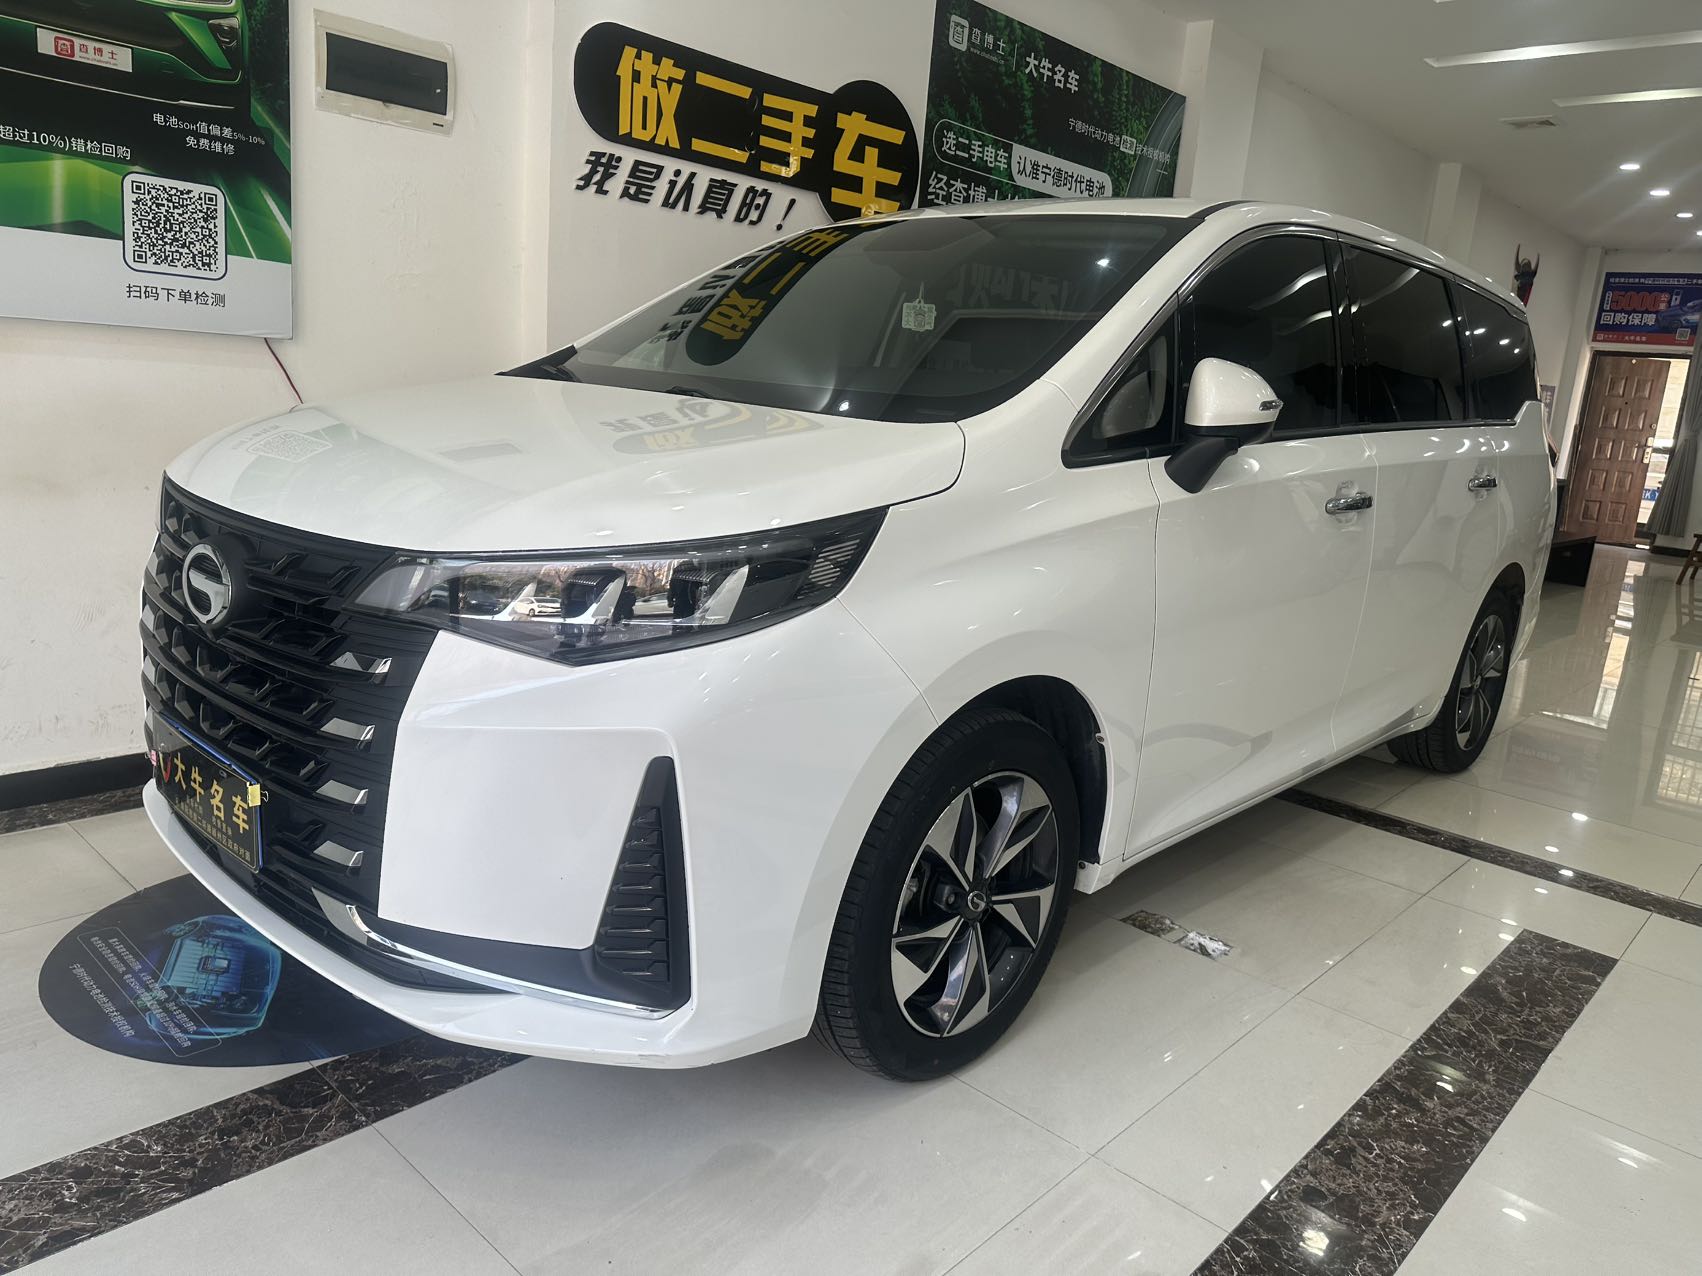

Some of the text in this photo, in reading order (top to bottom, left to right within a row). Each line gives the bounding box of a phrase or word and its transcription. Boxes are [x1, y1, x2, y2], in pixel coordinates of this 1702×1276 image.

[970, 27, 1006, 56] 查博士
[1025, 53, 1080, 94] 大牛名车
[186, 135, 235, 155] 免费维修
[616, 45, 906, 226] 做二手车
[942, 130, 1008, 171] 选二手电车
[1016, 156, 1105, 197] 认准宁德时代电池
[126, 283, 227, 309] 扫码下单检测
[1600, 312, 1657, 326] 回购保障
[174, 752, 249, 834] 大牛名车
